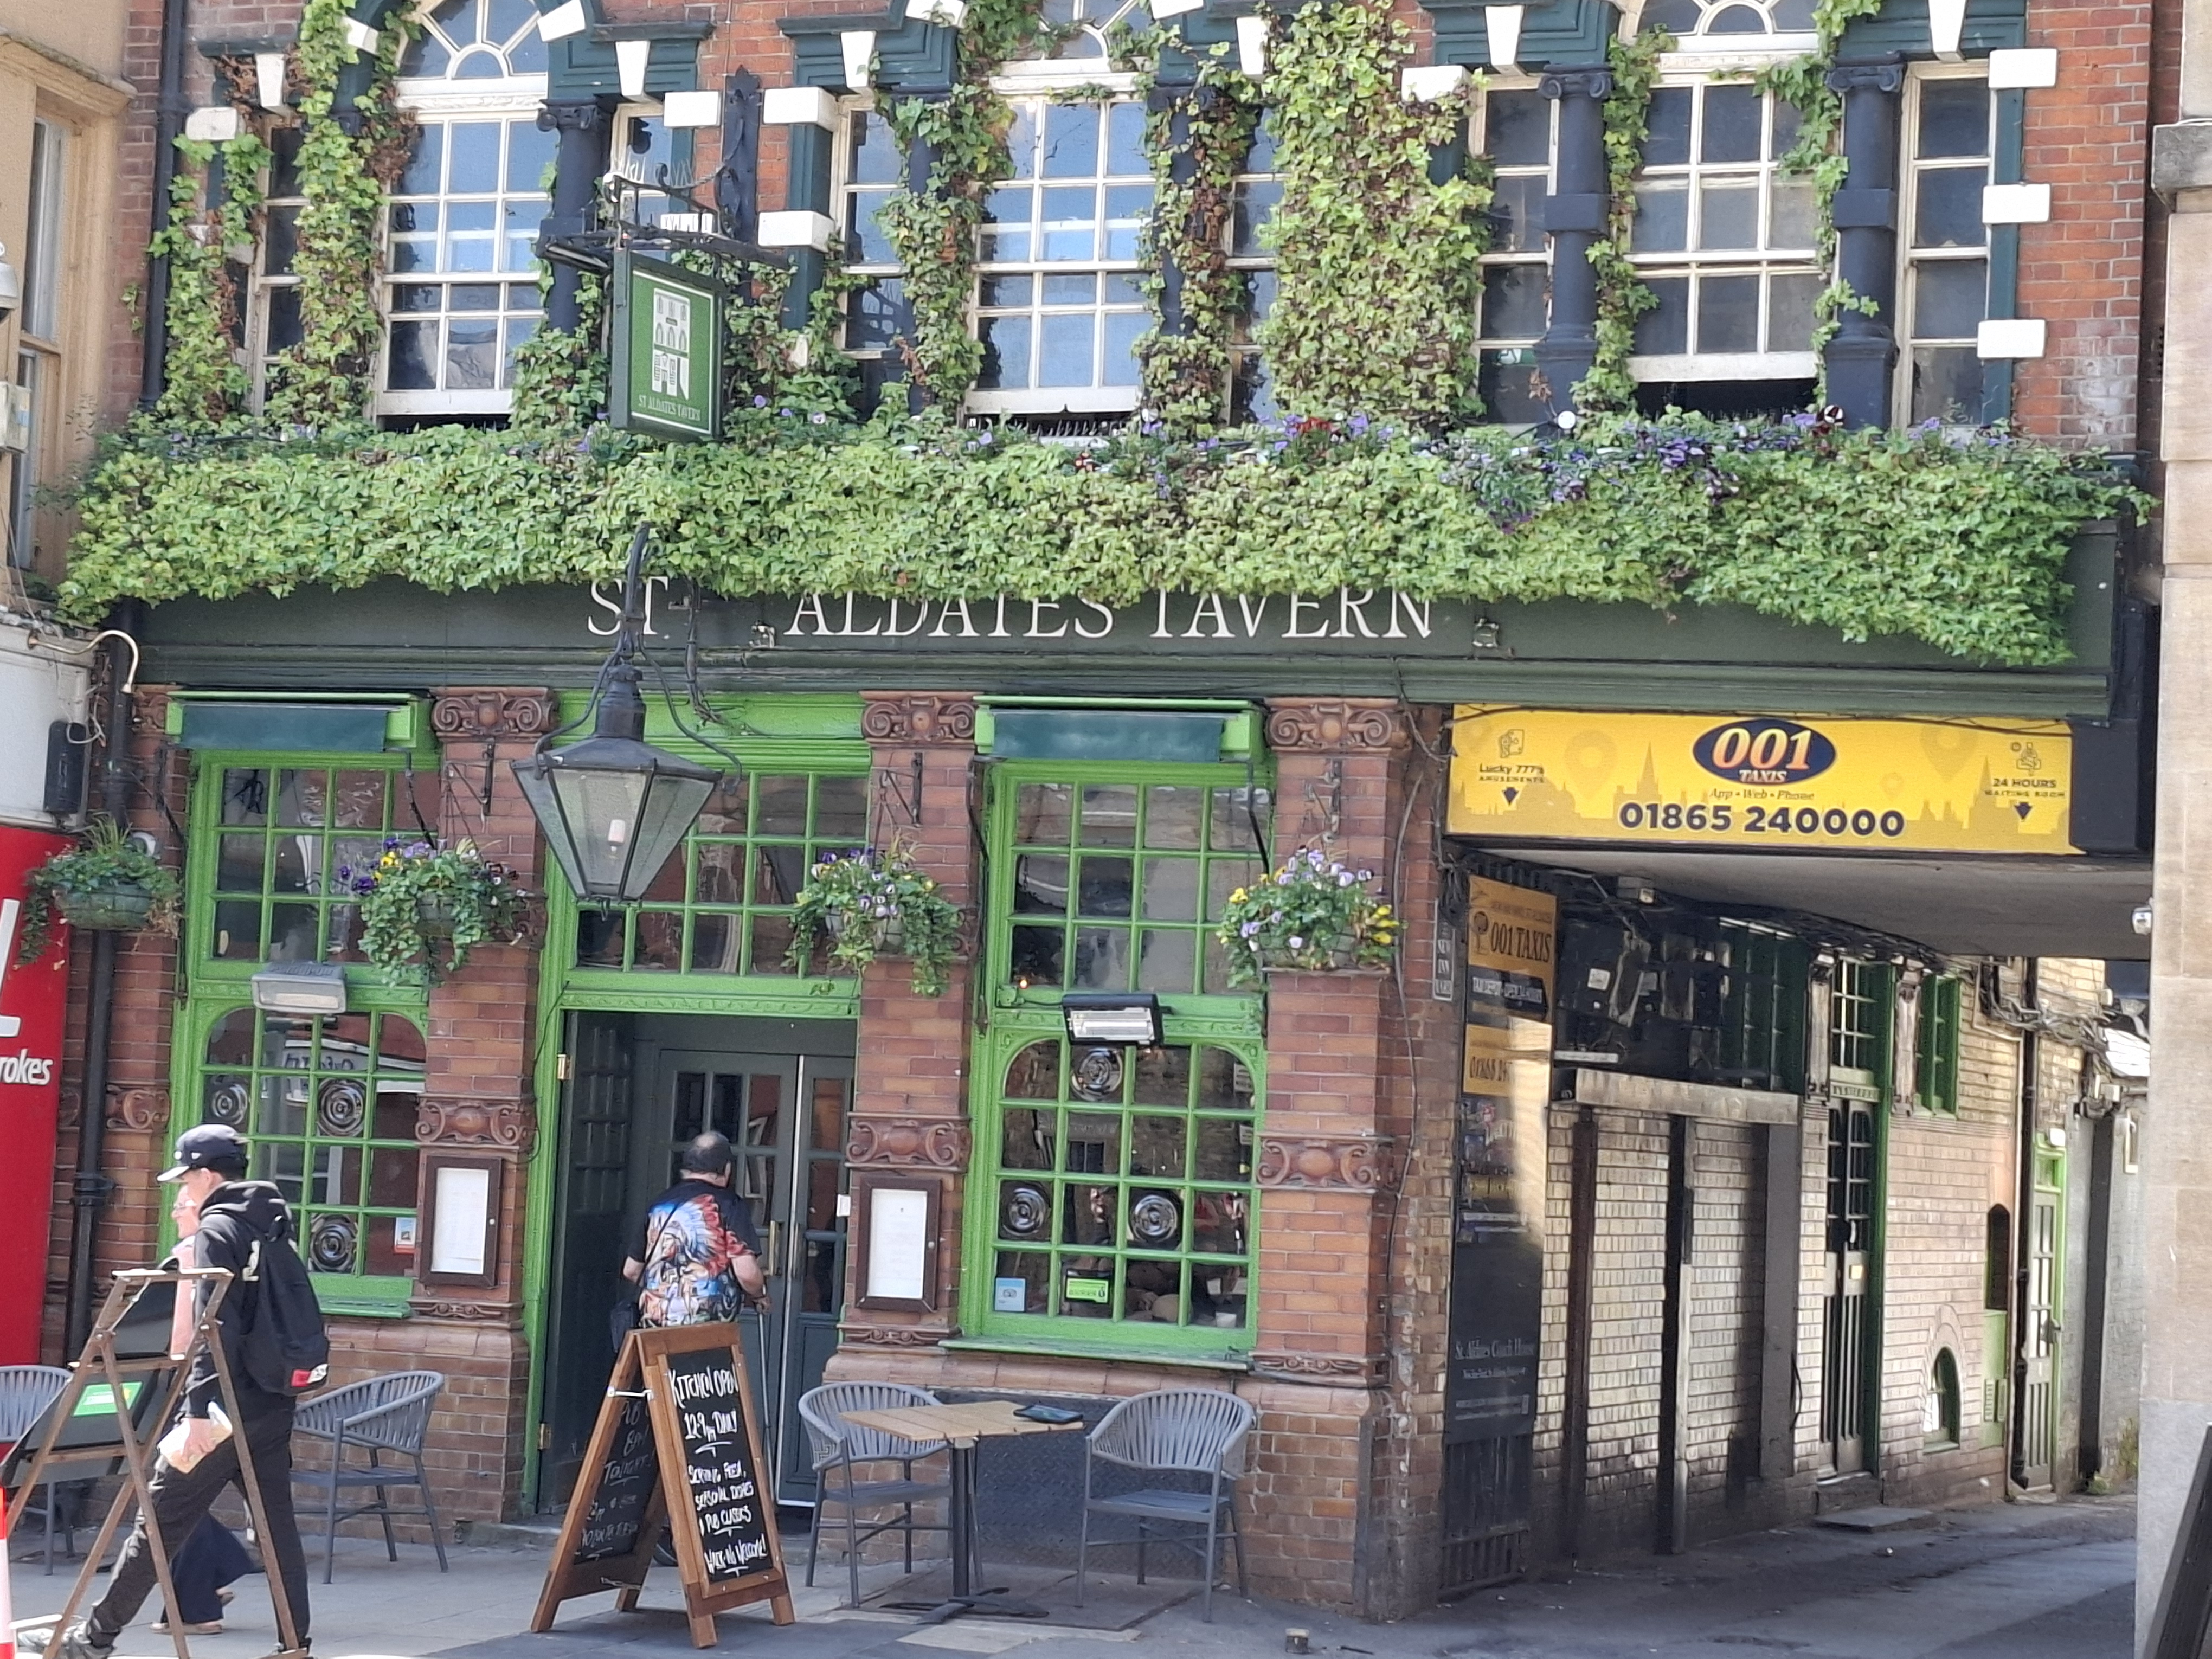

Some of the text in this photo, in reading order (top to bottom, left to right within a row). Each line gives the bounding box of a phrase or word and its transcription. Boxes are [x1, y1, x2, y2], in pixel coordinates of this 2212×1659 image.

[1712, 728, 1811, 770] 001
[1739, 770, 1787, 782] TAXIS
[1993, 778, 2056, 788] 24 HOURS
[1709, 788, 1733, 800] App
[1744, 789, 1767, 799] Web
[1619, 802, 1904, 837] 01865 240000
[1491, 922, 1552, 963] 001 TAXIS
[668, 1363, 738, 1409] KITCHEN OPEN
